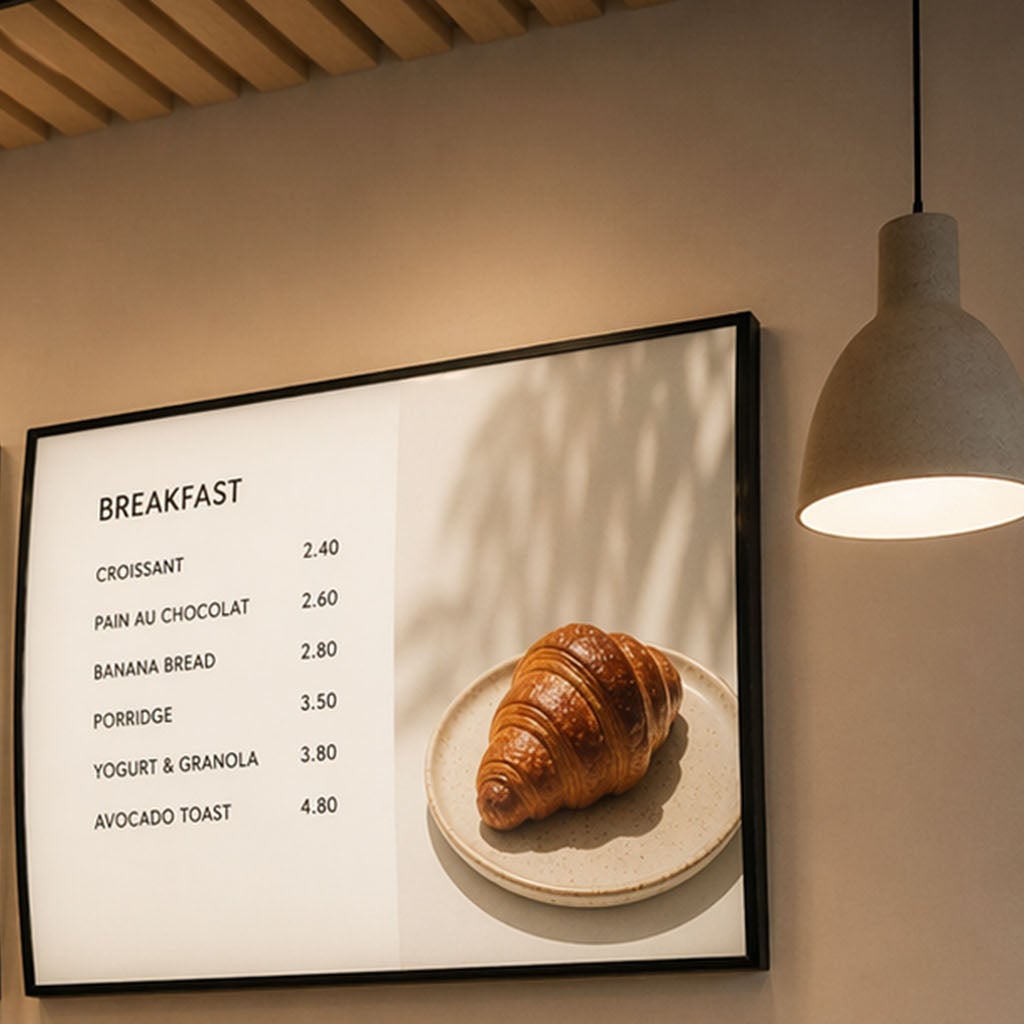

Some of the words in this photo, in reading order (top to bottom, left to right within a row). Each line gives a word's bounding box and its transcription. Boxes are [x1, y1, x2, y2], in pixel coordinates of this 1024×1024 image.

[99, 477, 243, 522] BREAKFAST
[303, 538, 340, 559] 2.40
[95, 556, 185, 583] CROISSANT
[301, 589, 339, 609] 2.60
[94, 612, 130, 631] PAIN
[133, 609, 156, 627] AU
[160, 598, 250, 624] CHOCOLAT
[301, 640, 338, 660] 2.80
[94, 659, 160, 681] BANANA
[164, 652, 216, 674] BREAD
[300, 691, 337, 712] 3.50
[93, 706, 173, 730] PORRIDGE
[93, 758, 158, 779] YOGURT
[162, 757, 174, 774] &
[178, 750, 259, 773] GRANOLA
[300, 743, 337, 764] 3.80
[94, 807, 175, 830] AVOCADO
[179, 803, 232, 823] TOAST
[300, 795, 338, 815] 4.80
